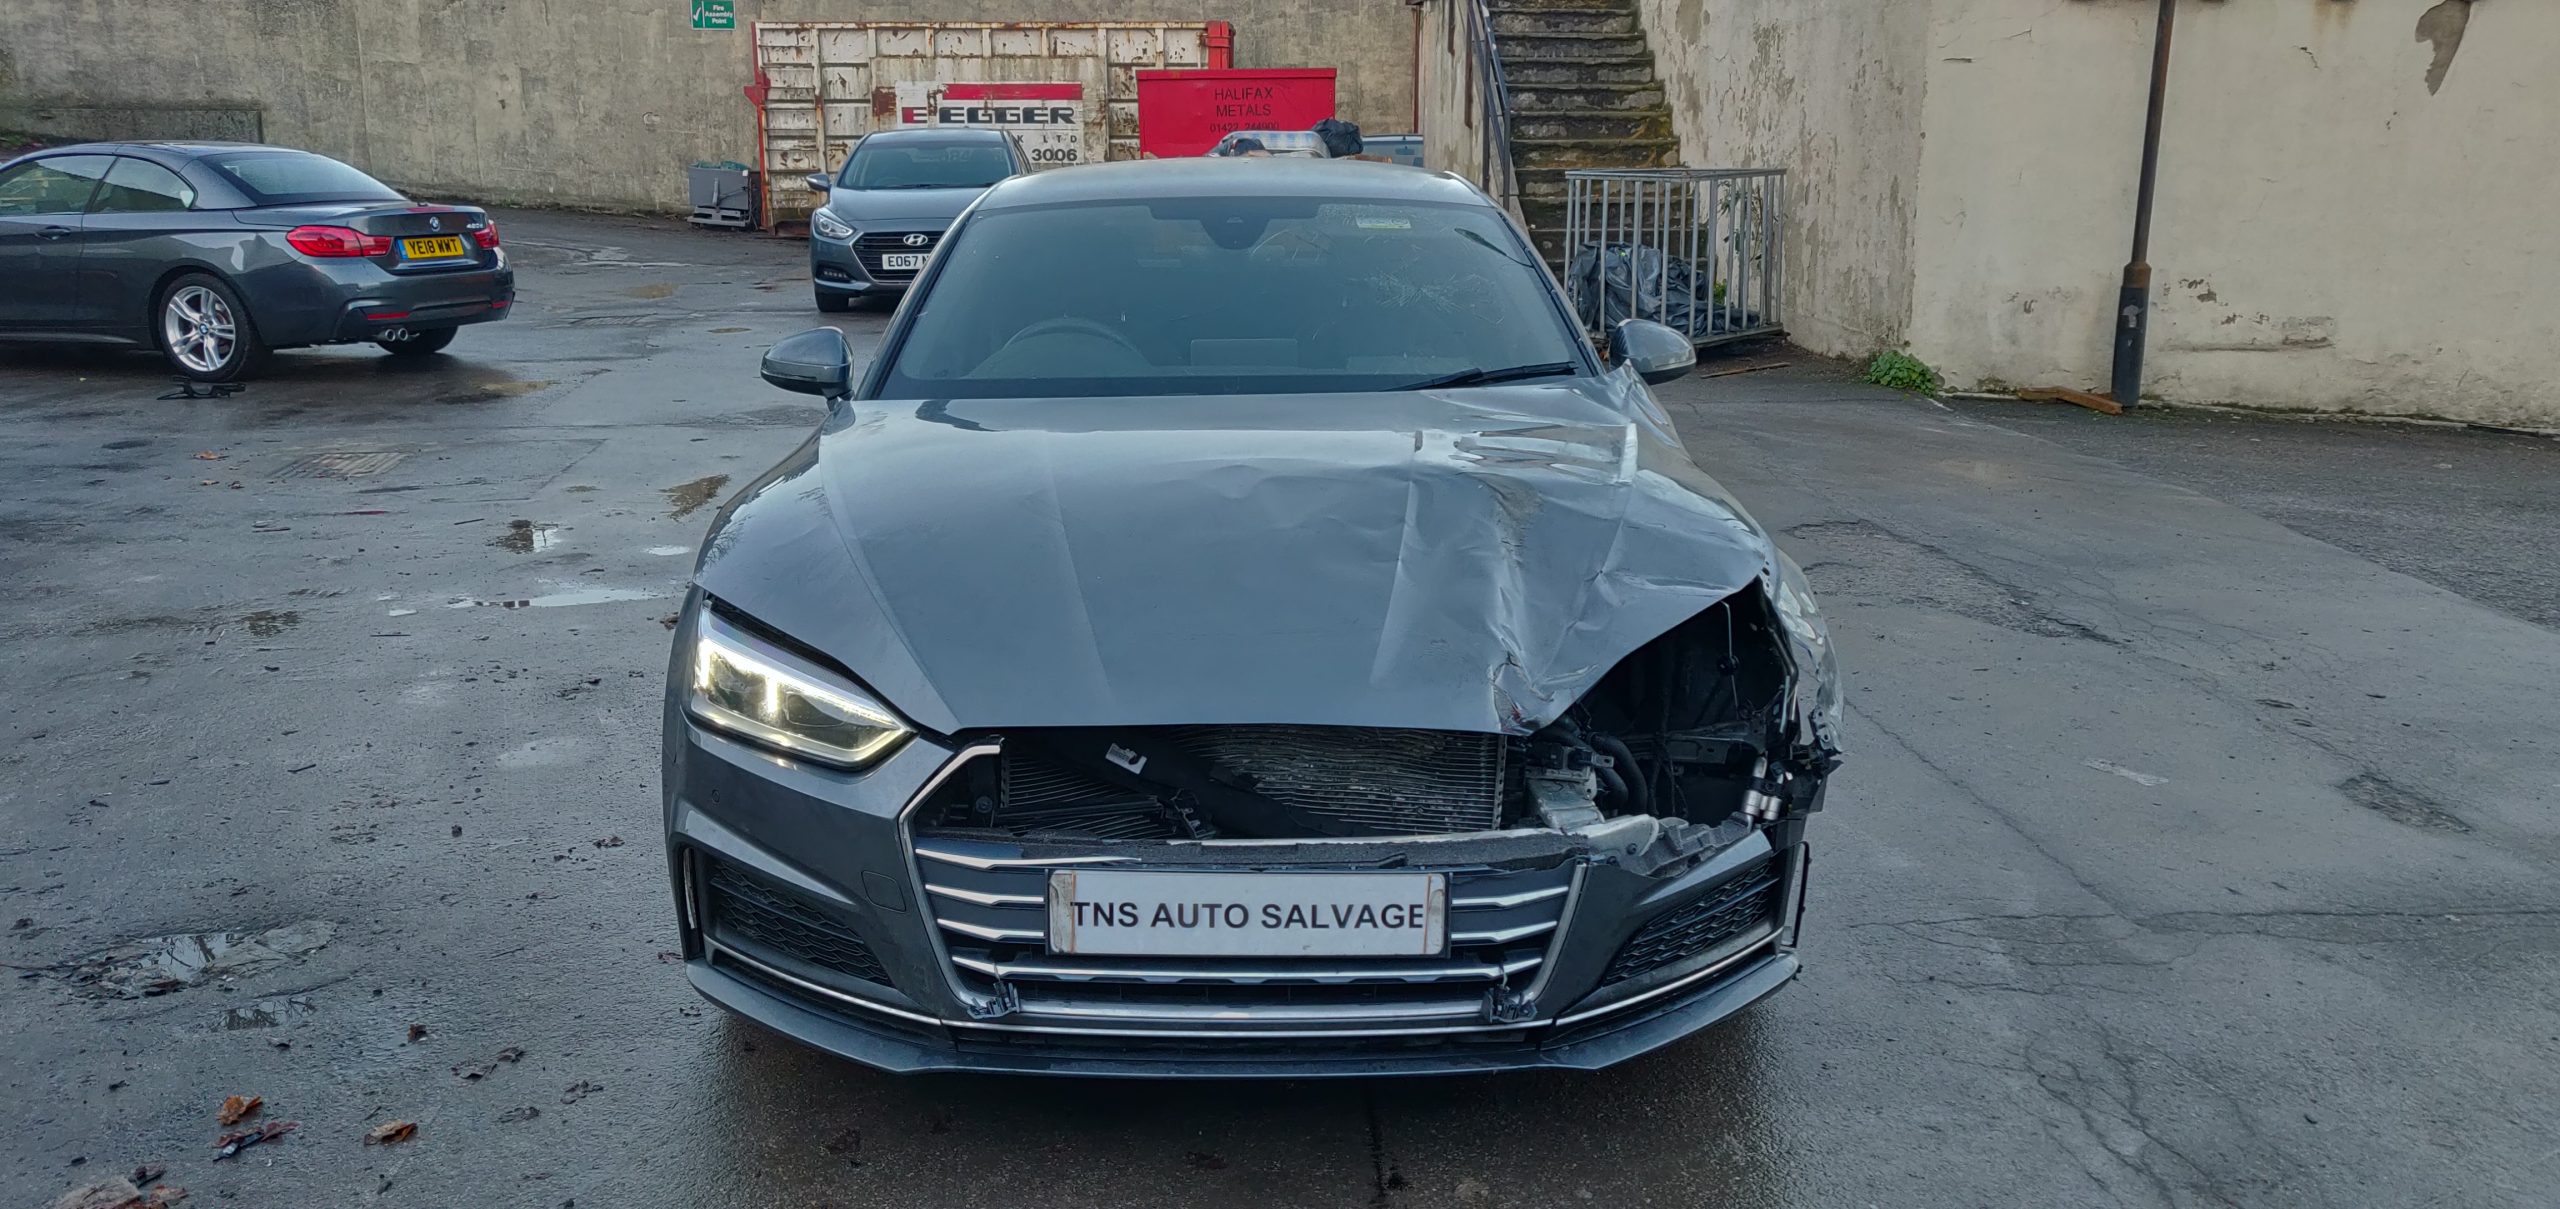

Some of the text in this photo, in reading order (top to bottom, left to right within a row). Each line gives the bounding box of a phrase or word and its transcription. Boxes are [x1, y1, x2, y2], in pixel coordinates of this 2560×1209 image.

[1214, 87, 1273, 100] HALIFAX
[939, 107, 1076, 124] EGGER
[1216, 104, 1272, 117] METALS
[1031, 148, 1078, 162] 3006
[408, 239, 457, 255] YE18 WWT
[887, 255, 919, 267] EO67
[1070, 901, 1424, 930] TNS AUTO SALVAGE
